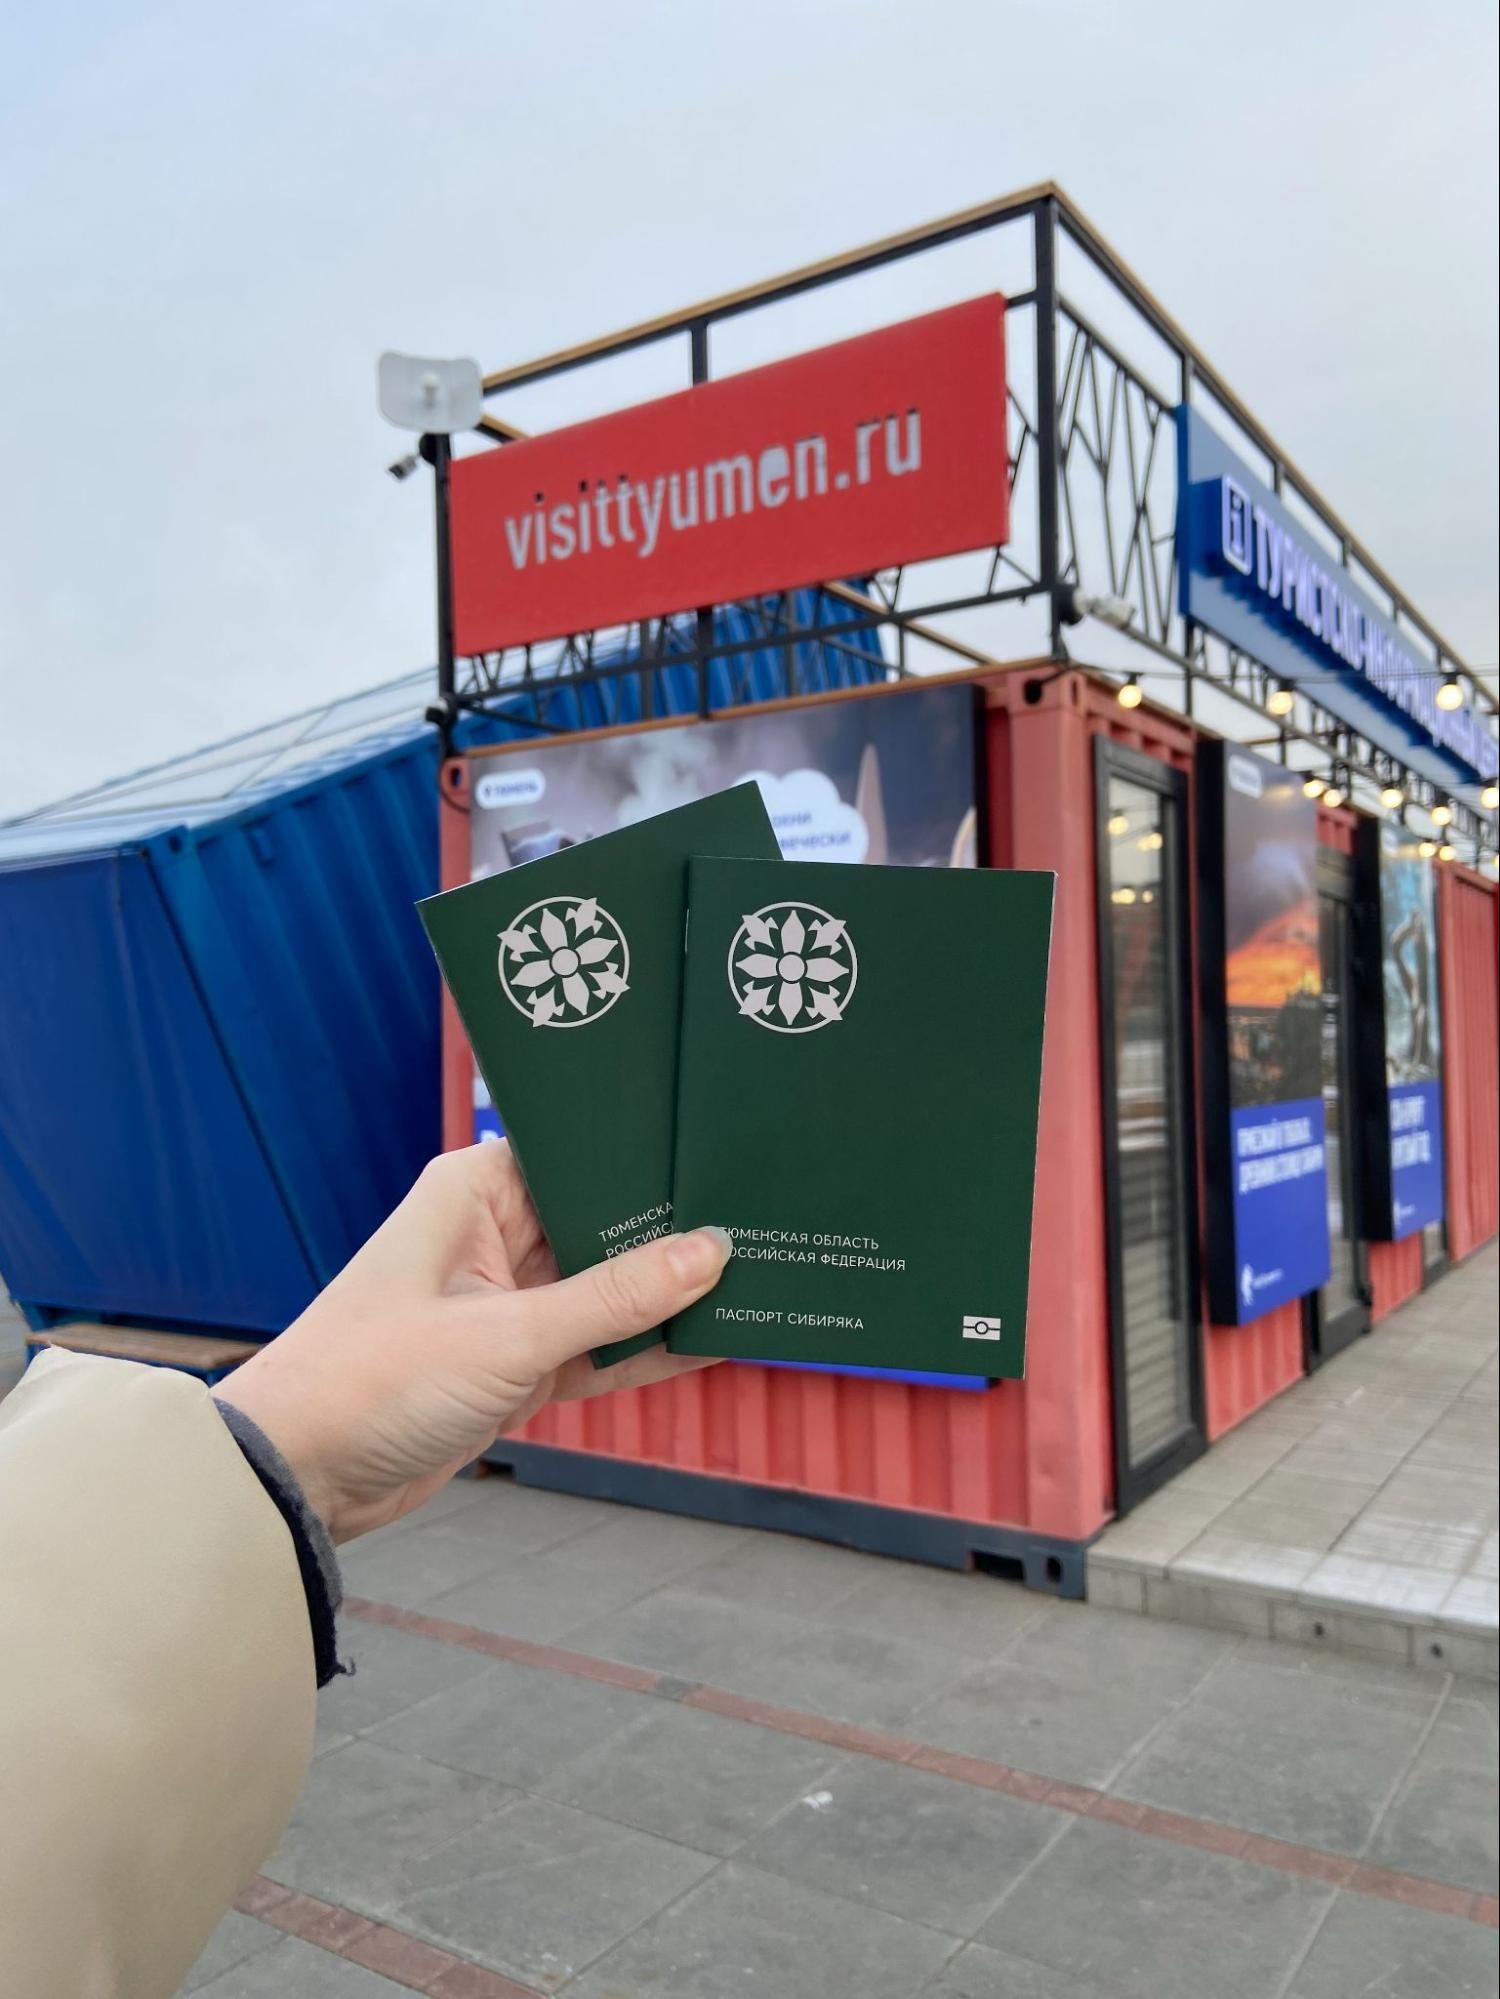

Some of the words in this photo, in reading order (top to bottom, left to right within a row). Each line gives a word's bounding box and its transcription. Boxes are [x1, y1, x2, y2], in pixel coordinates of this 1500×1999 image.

[505, 408, 921, 570] visittyumen.ru
[598, 1201, 673, 1242] ТЮМЕНСКА
[605, 1221, 674, 1259] РОССИЙС
[813, 1234, 879, 1250] ОБЛАСТЬ
[731, 1246, 815, 1263] ОССИЙСКАЯ
[820, 1253, 906, 1271] ФЕДЕРАЦИЯ
[715, 1307, 783, 1323] ПАСПОРТ
[787, 1312, 864, 1330] СИБИРЯКА
